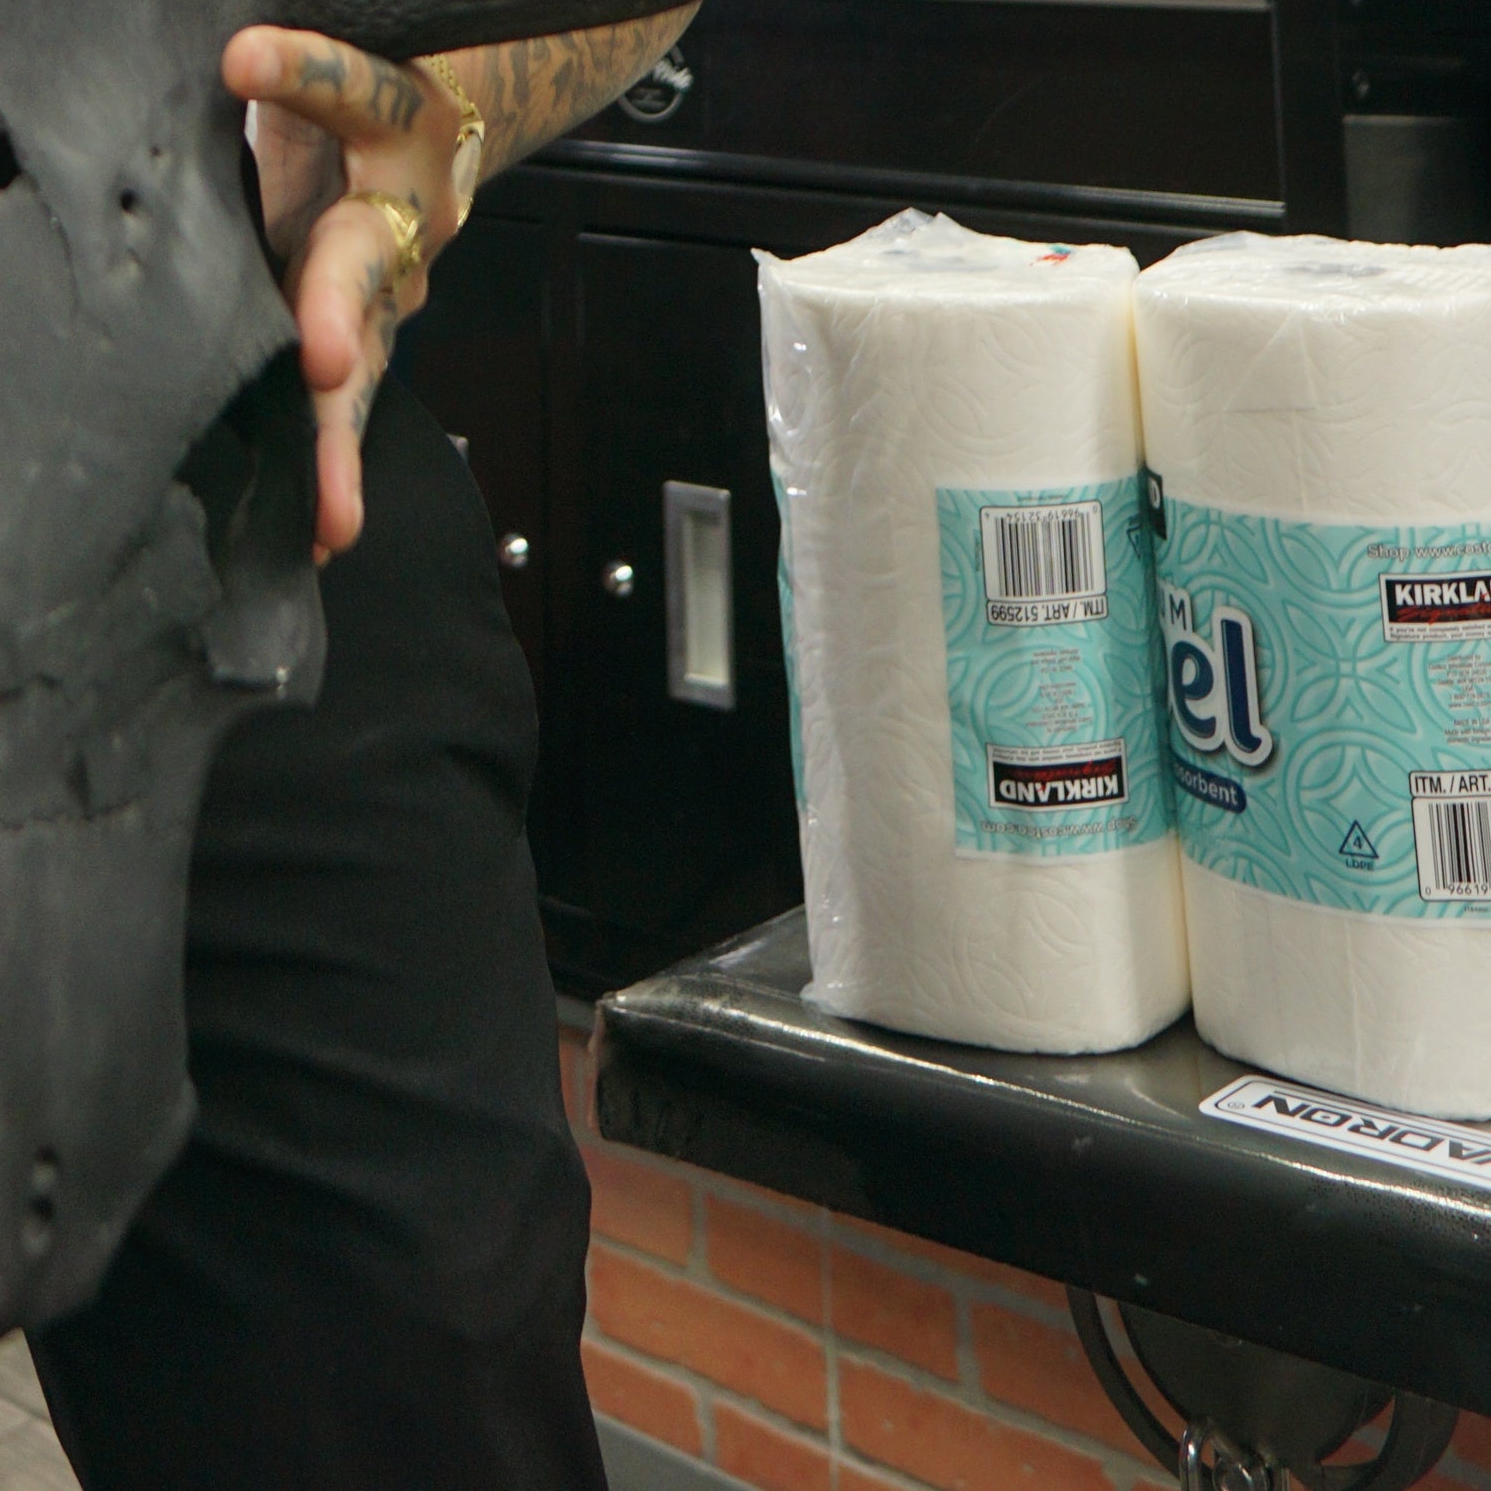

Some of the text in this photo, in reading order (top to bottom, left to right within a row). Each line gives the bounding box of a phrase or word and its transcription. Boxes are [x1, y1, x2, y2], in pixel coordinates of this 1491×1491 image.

[1368, 543, 1410, 563] Shop
[1395, 580, 1491, 606] KIRKLA
[991, 604, 1038, 622] 512599
[1042, 602, 1070, 621] ART.
[1082, 598, 1106, 617] ITM.
[999, 774, 1119, 803] KIRKLAND
[1414, 776, 1446, 793] ITM.
[1252, 1094, 1491, 1165] ADRON
